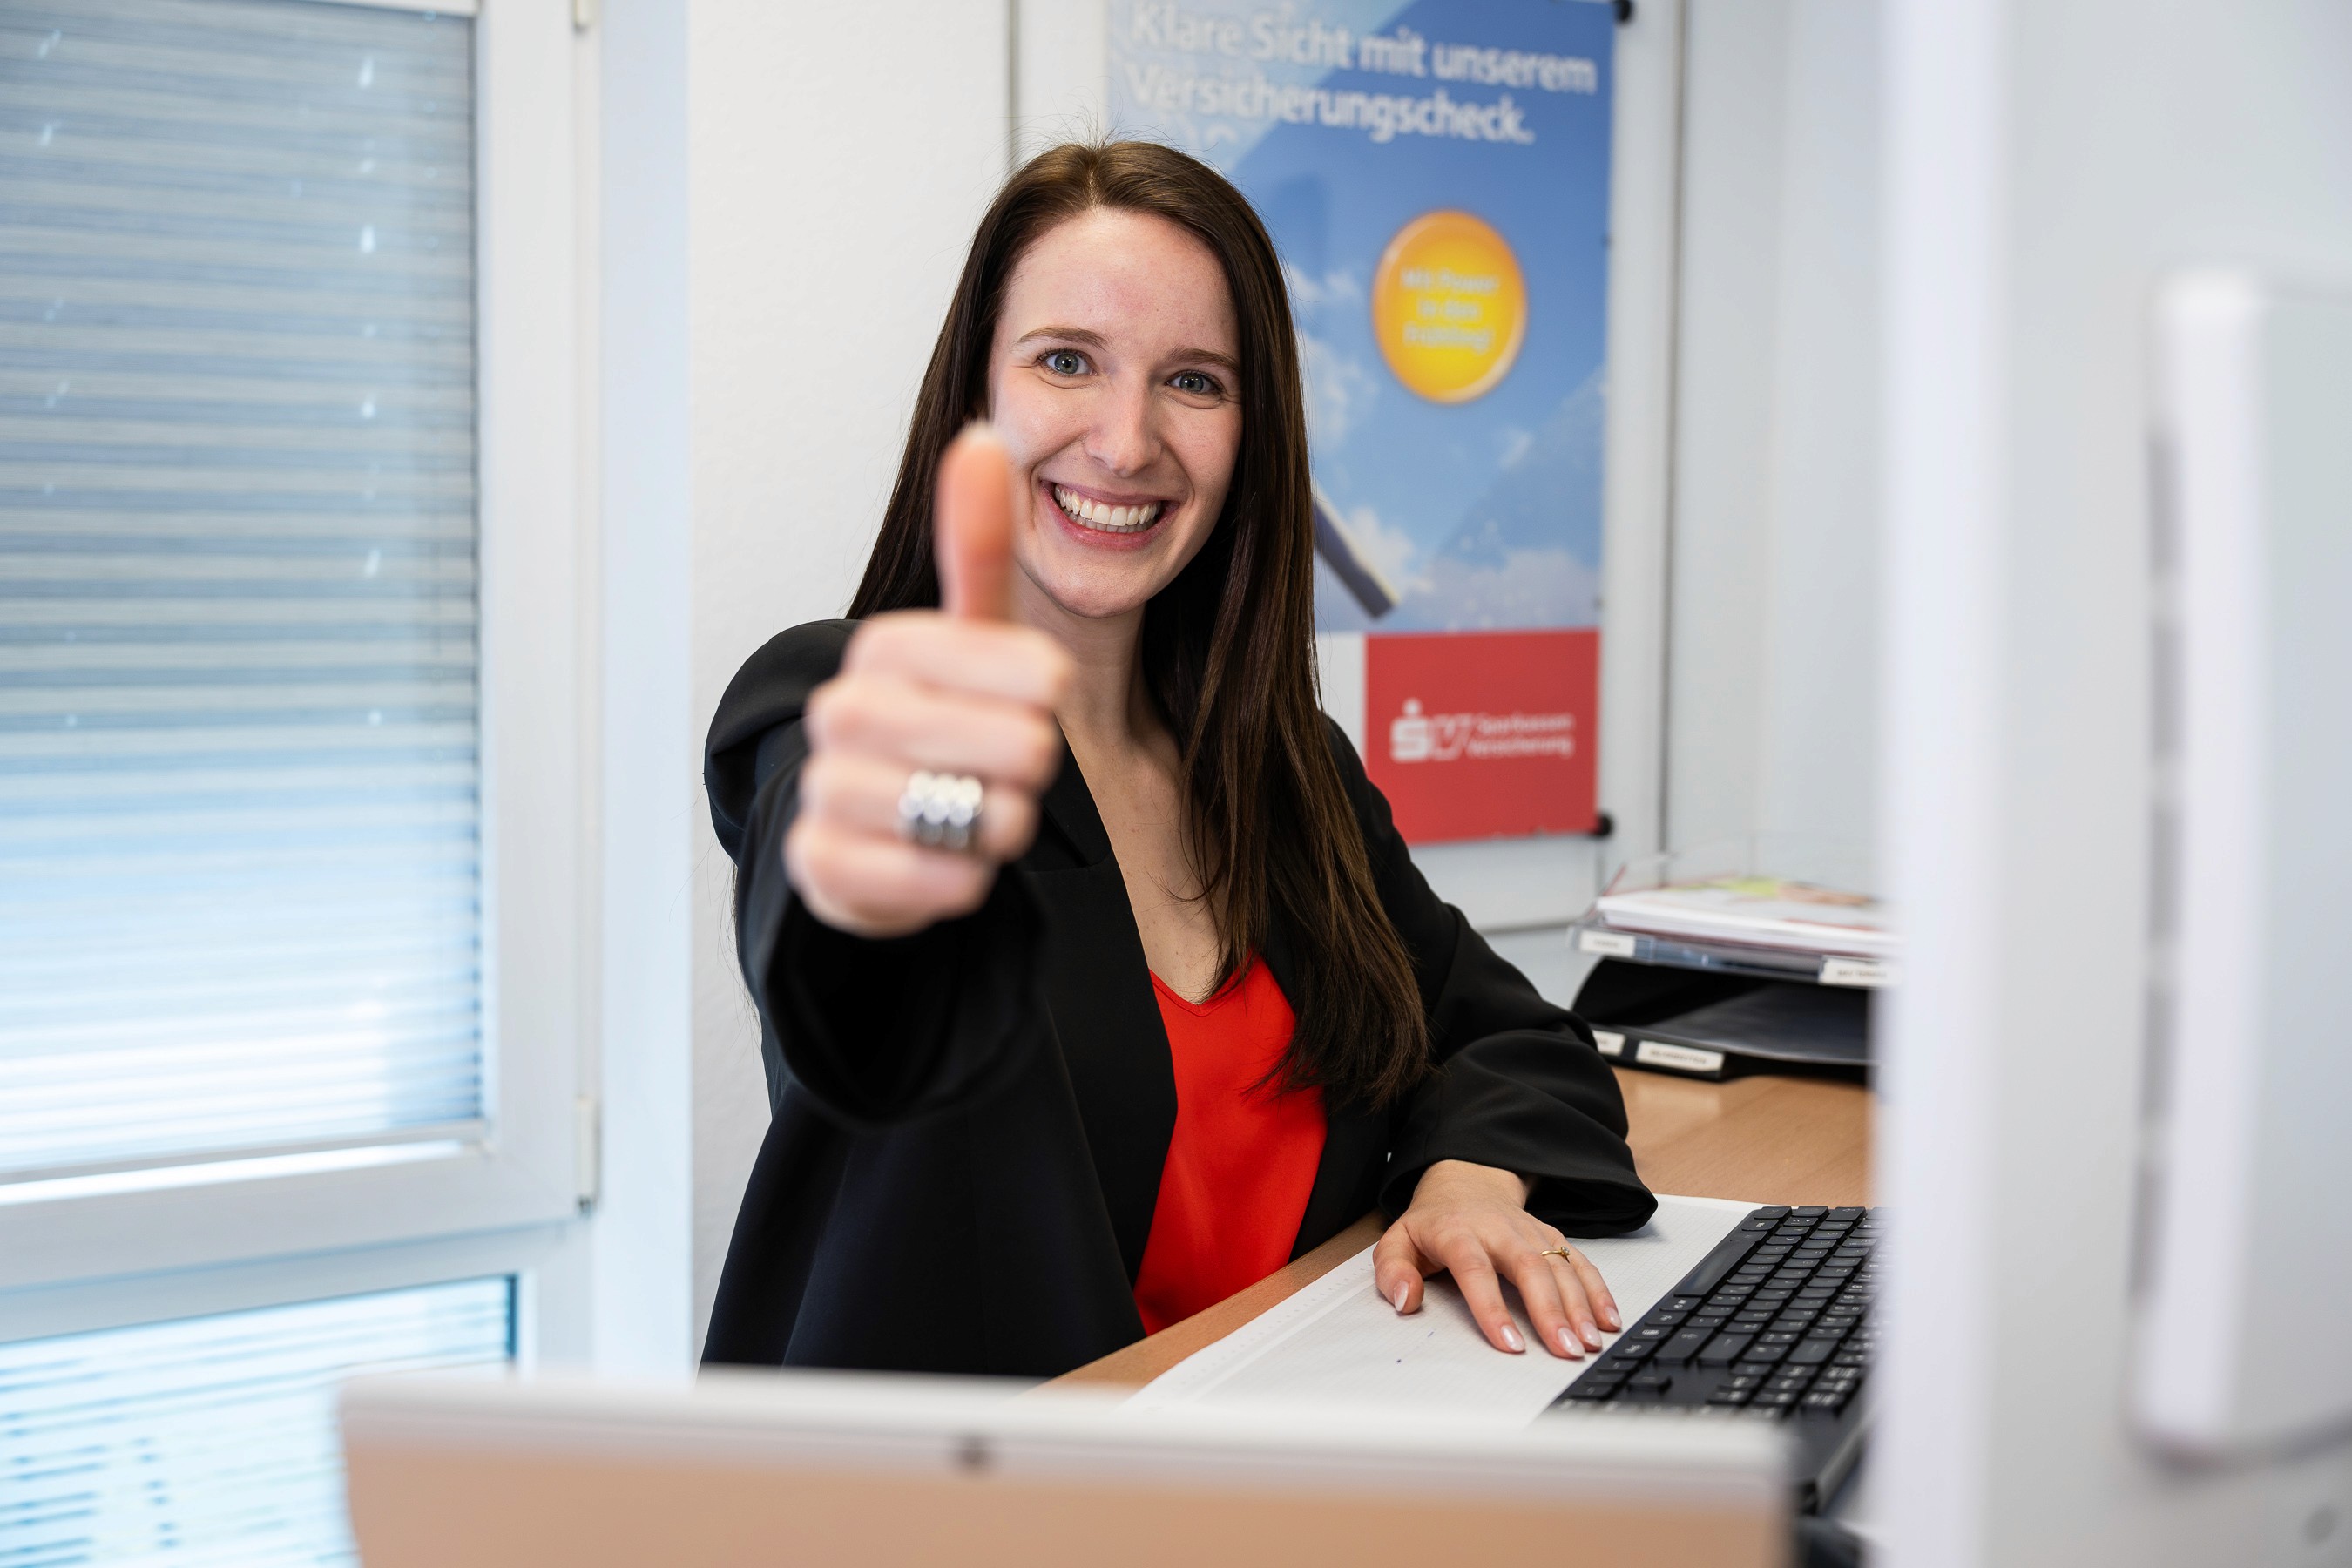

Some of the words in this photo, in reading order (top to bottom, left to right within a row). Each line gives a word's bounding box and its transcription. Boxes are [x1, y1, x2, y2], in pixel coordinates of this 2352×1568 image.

[1130, 2, 1241, 56] Klare
[1248, 5, 1355, 69] Sicht
[1358, 25, 1427, 78] mit
[1432, 41, 1597, 95] unserem
[1125, 62, 1536, 145] Versicherungscheck.
[1467, 734, 1575, 760] Versicherung
